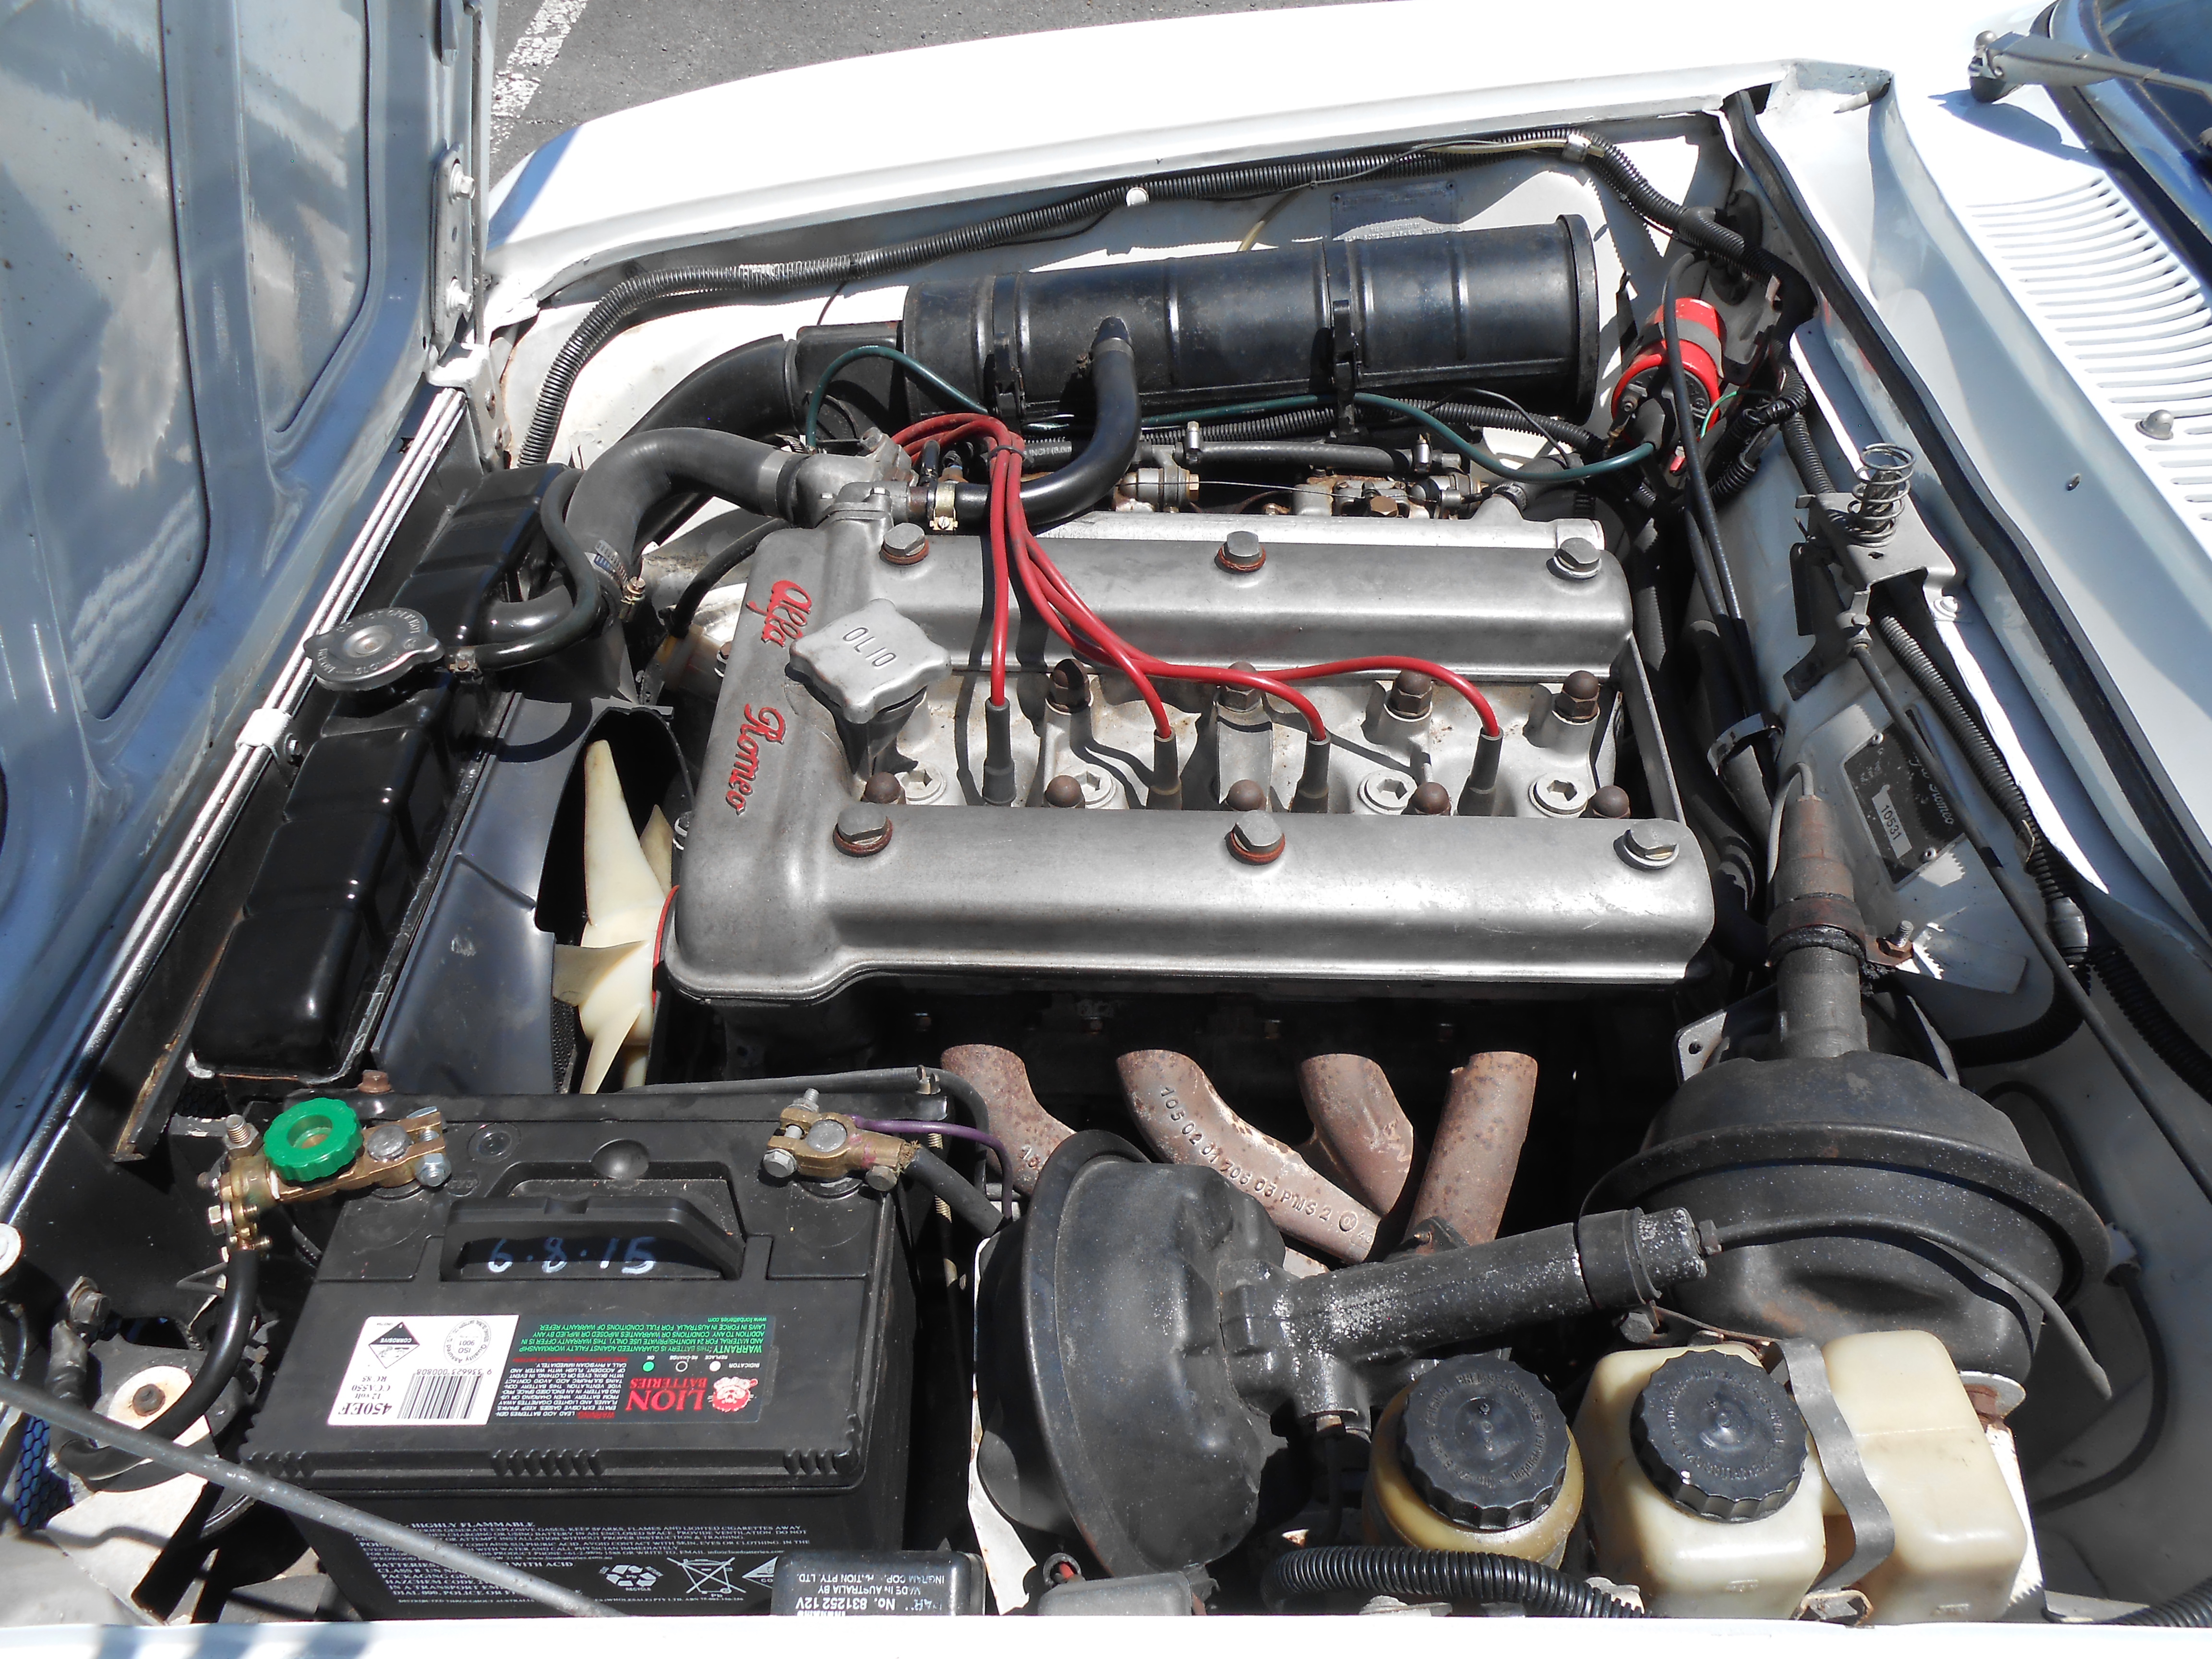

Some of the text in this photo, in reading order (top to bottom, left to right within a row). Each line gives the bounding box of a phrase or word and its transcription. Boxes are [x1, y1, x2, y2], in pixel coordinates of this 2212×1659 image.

[1029, 447, 1049, 456] INCH
[746, 580, 812, 647] Alfa
[842, 627, 897, 670] OLIO
[726, 704, 788, 815] Romeo
[1880, 804, 1901, 840] 10531
[1161, 1087, 1185, 1121] 105
[1182, 1122, 1204, 1145] 02
[446, 1344, 487, 1363] Quality Assured
[629, 1377, 708, 1389] BATTERIES
[625, 1389, 706, 1411] LION
[338, 1402, 393, 1415] 450EF
[797, 1574, 816, 1582] LTD.
[909, 1575, 945, 1584] INGRAM
[818, 1586, 830, 1595] BY
[832, 1585, 882, 1595] AUSTRALIA
[795, 1597, 819, 1610] 12V
[822, 1597, 867, 1610] 831252
[874, 1598, 895, 1610] No.
